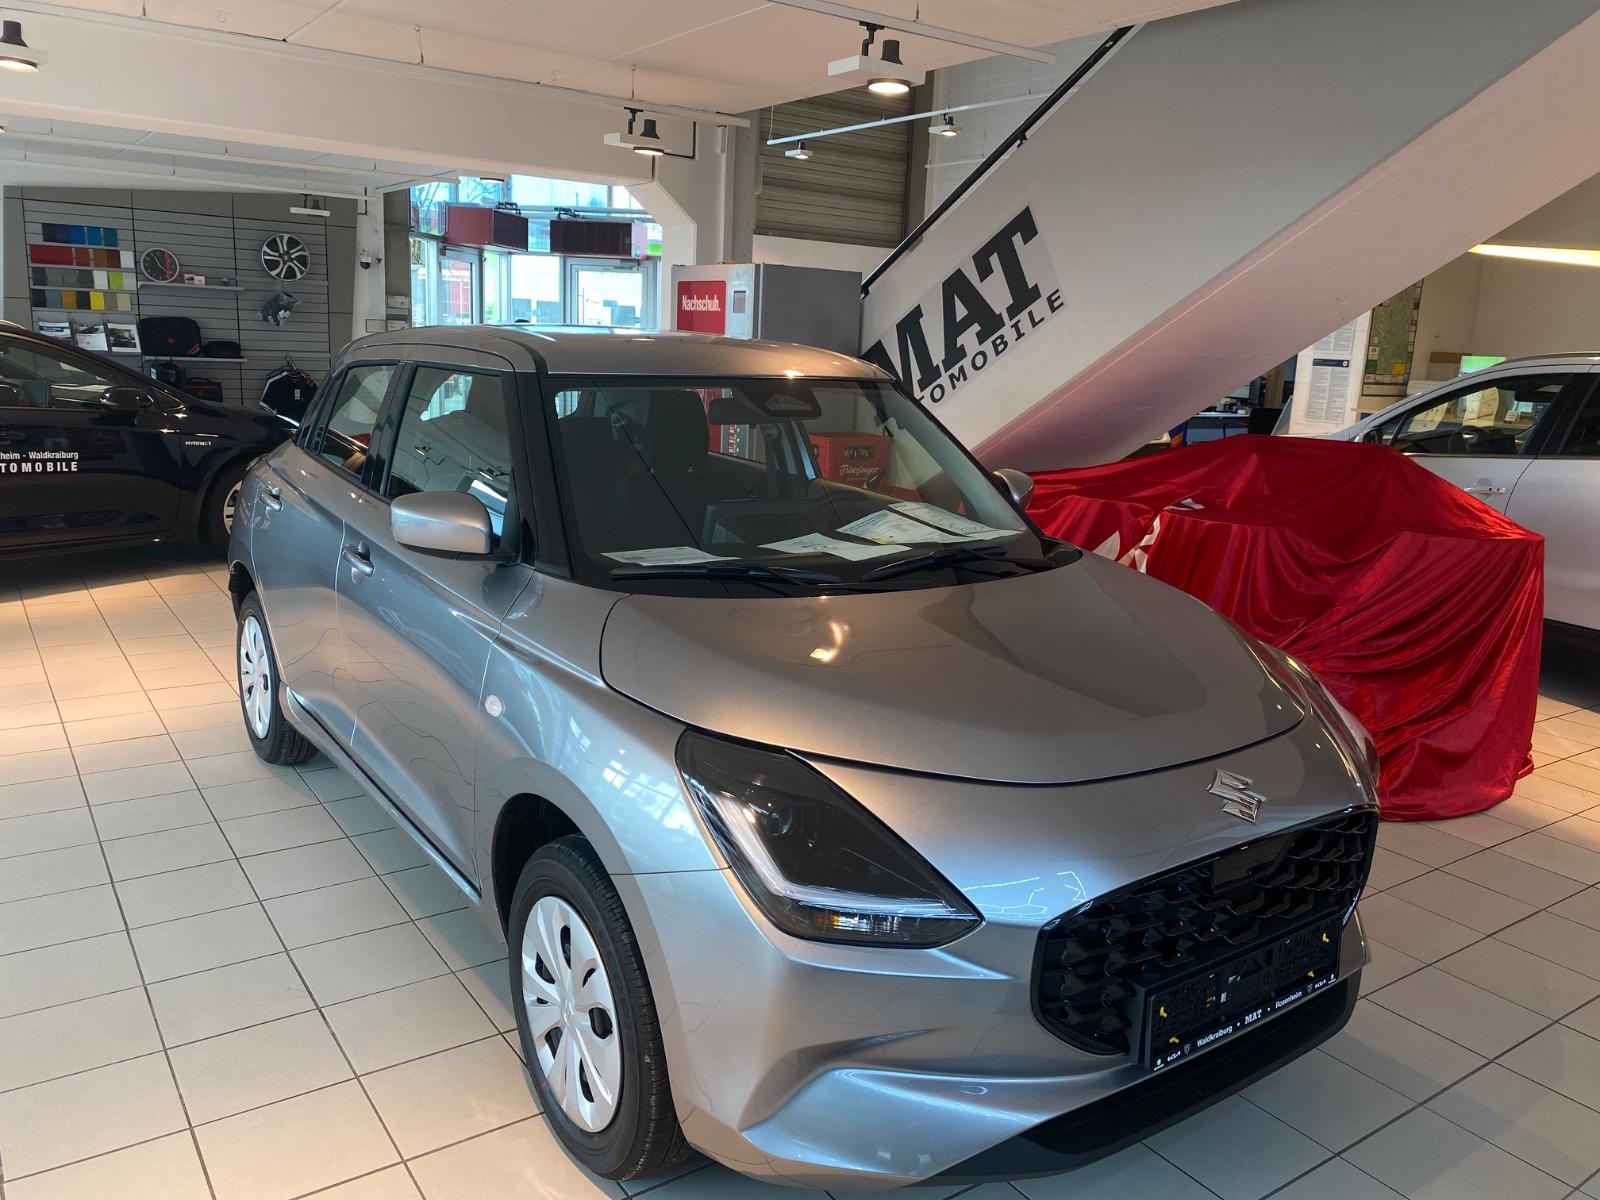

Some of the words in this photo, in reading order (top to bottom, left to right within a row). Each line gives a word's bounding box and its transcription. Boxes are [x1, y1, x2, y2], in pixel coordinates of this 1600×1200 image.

[681, 294, 721, 312] Nachschub.
[861, 205, 1041, 397] MAT
[920, 288, 1064, 403] OMOBILE
[29, 450, 79, 460] Waldkraiburg
[1244, 1009, 1263, 1025] MAT
